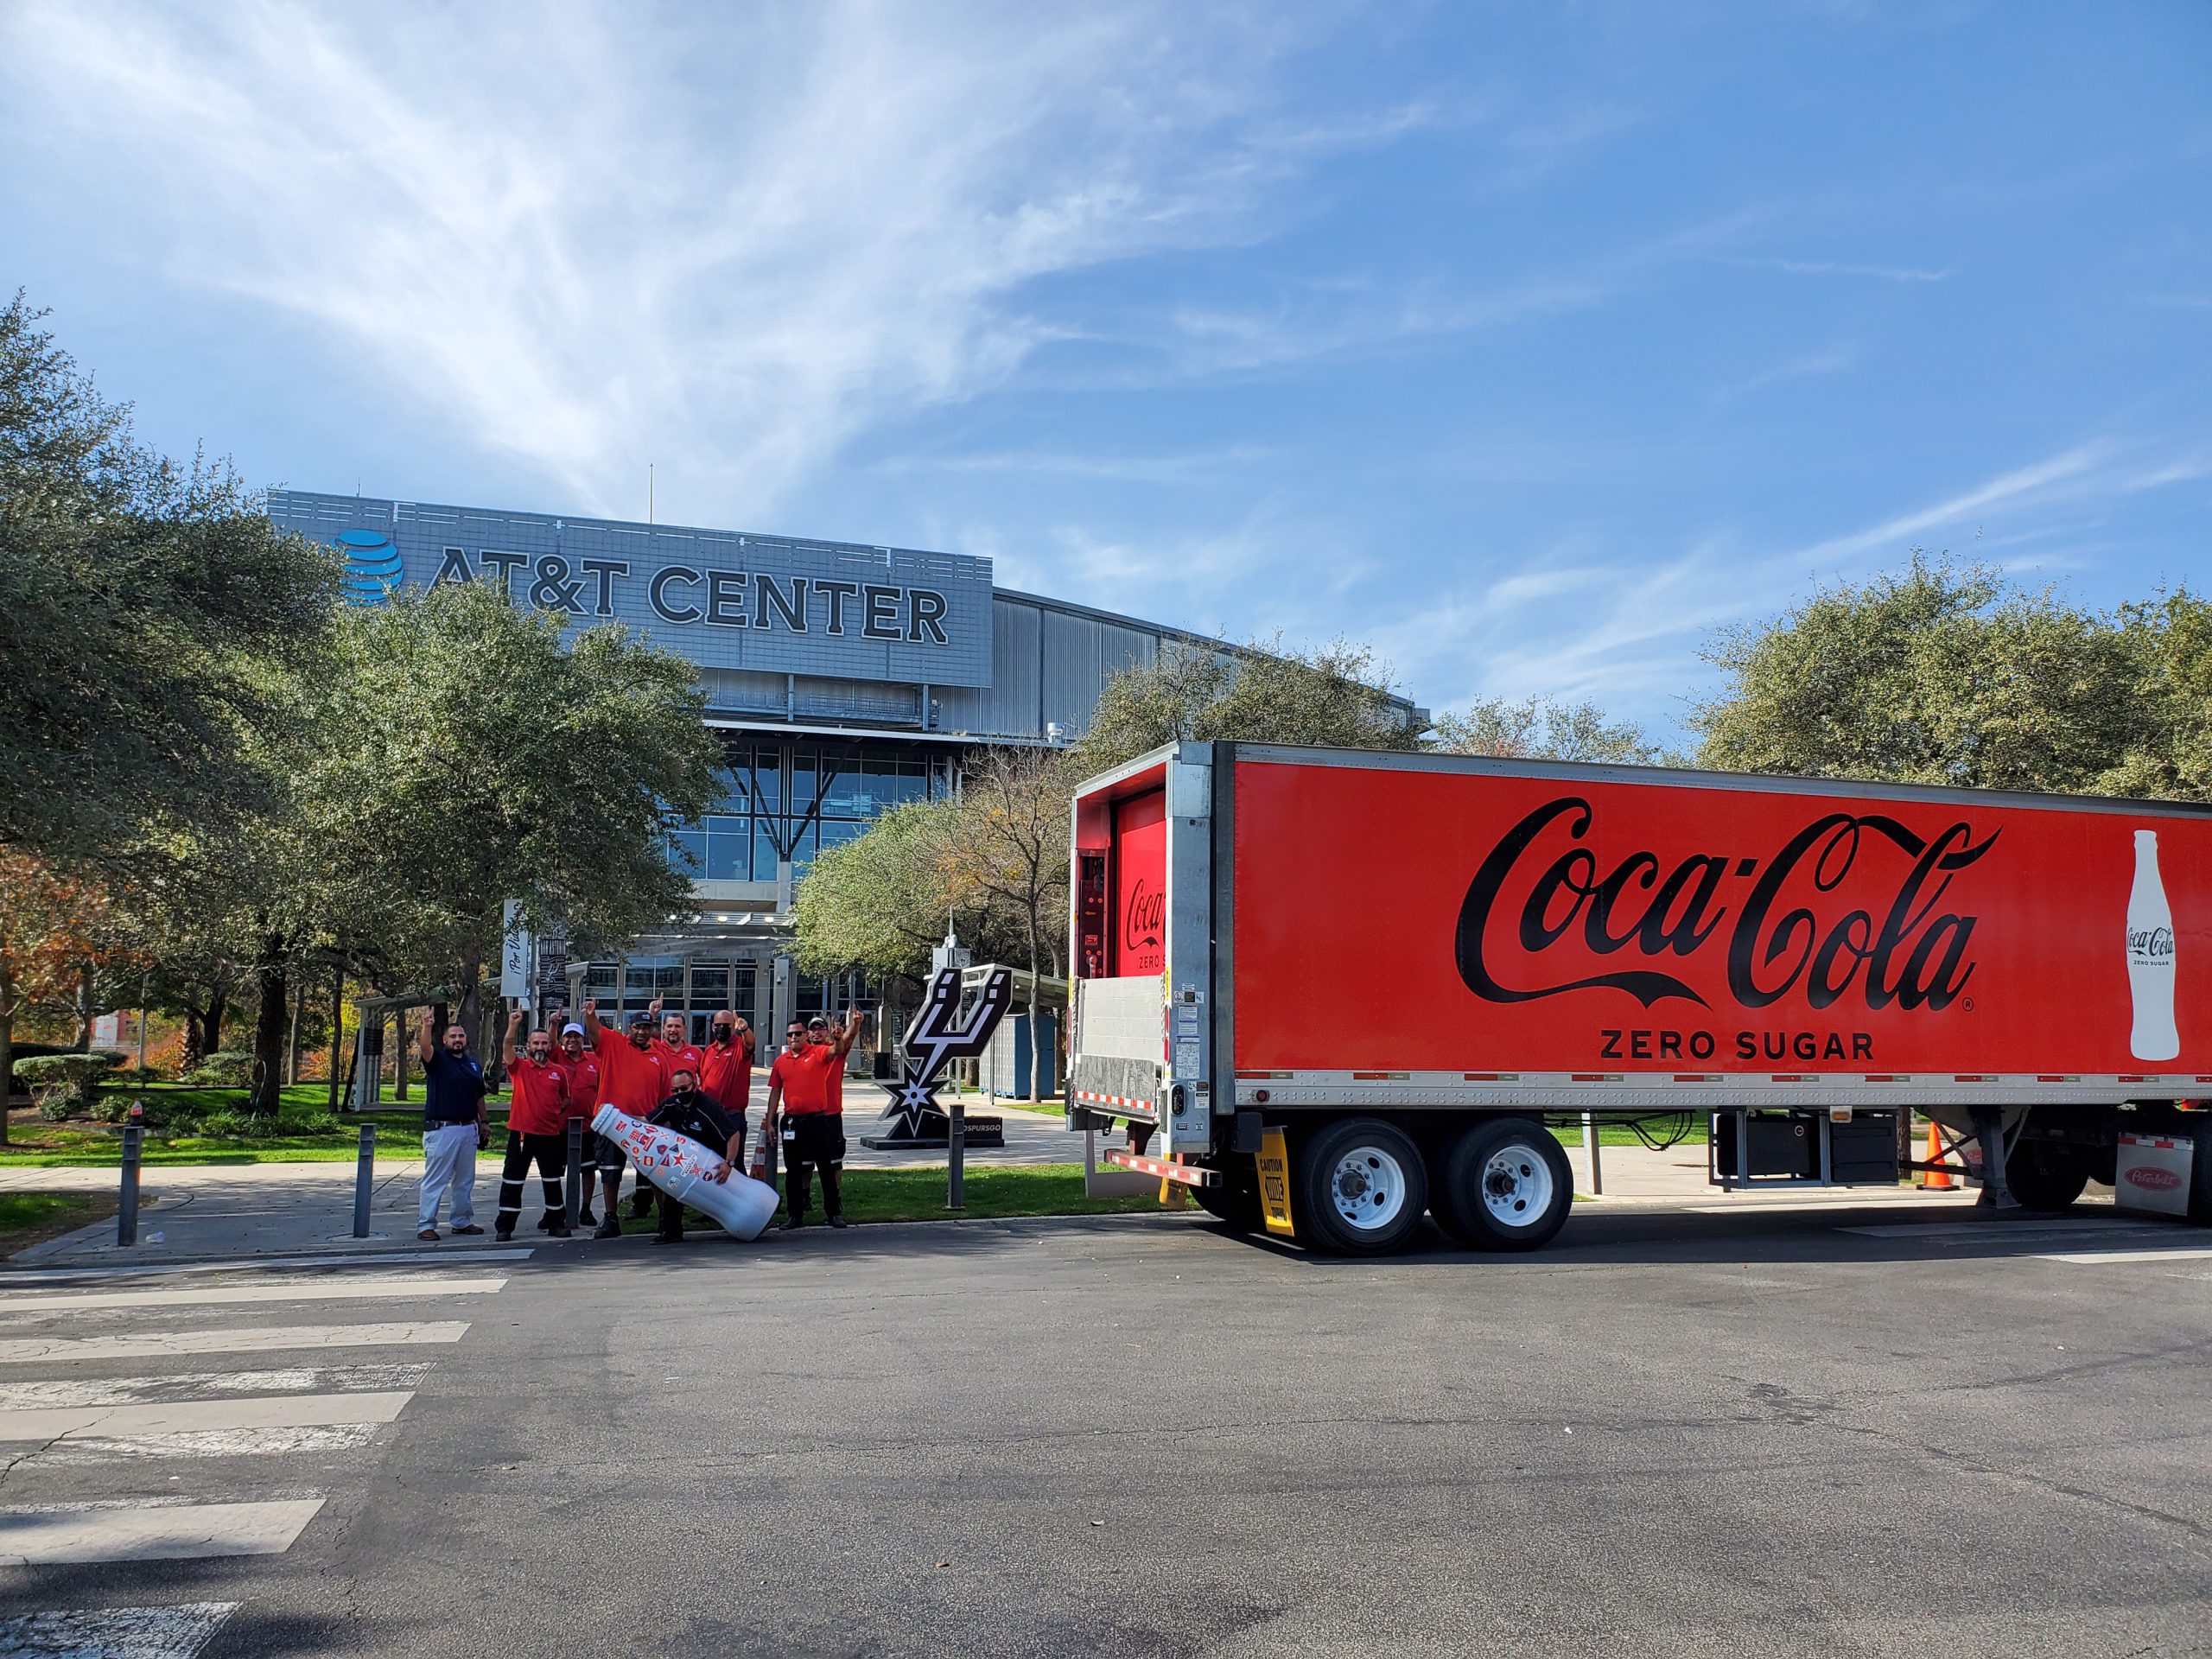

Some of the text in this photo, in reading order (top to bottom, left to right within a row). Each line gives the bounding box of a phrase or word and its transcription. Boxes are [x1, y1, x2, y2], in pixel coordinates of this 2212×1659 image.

[424, 546, 949, 645] AT&T CENTER
[1455, 797, 2003, 1011] Coca-Cola
[2127, 927, 2174, 957] Coca-Cola
[1139, 955, 1159, 969] ZERO
[1601, 1029, 1874, 1060] ZERO SUGAR
[1260, 1159, 1283, 1172] CAUTION
[2132, 1170, 2177, 1185] Peterbilt
